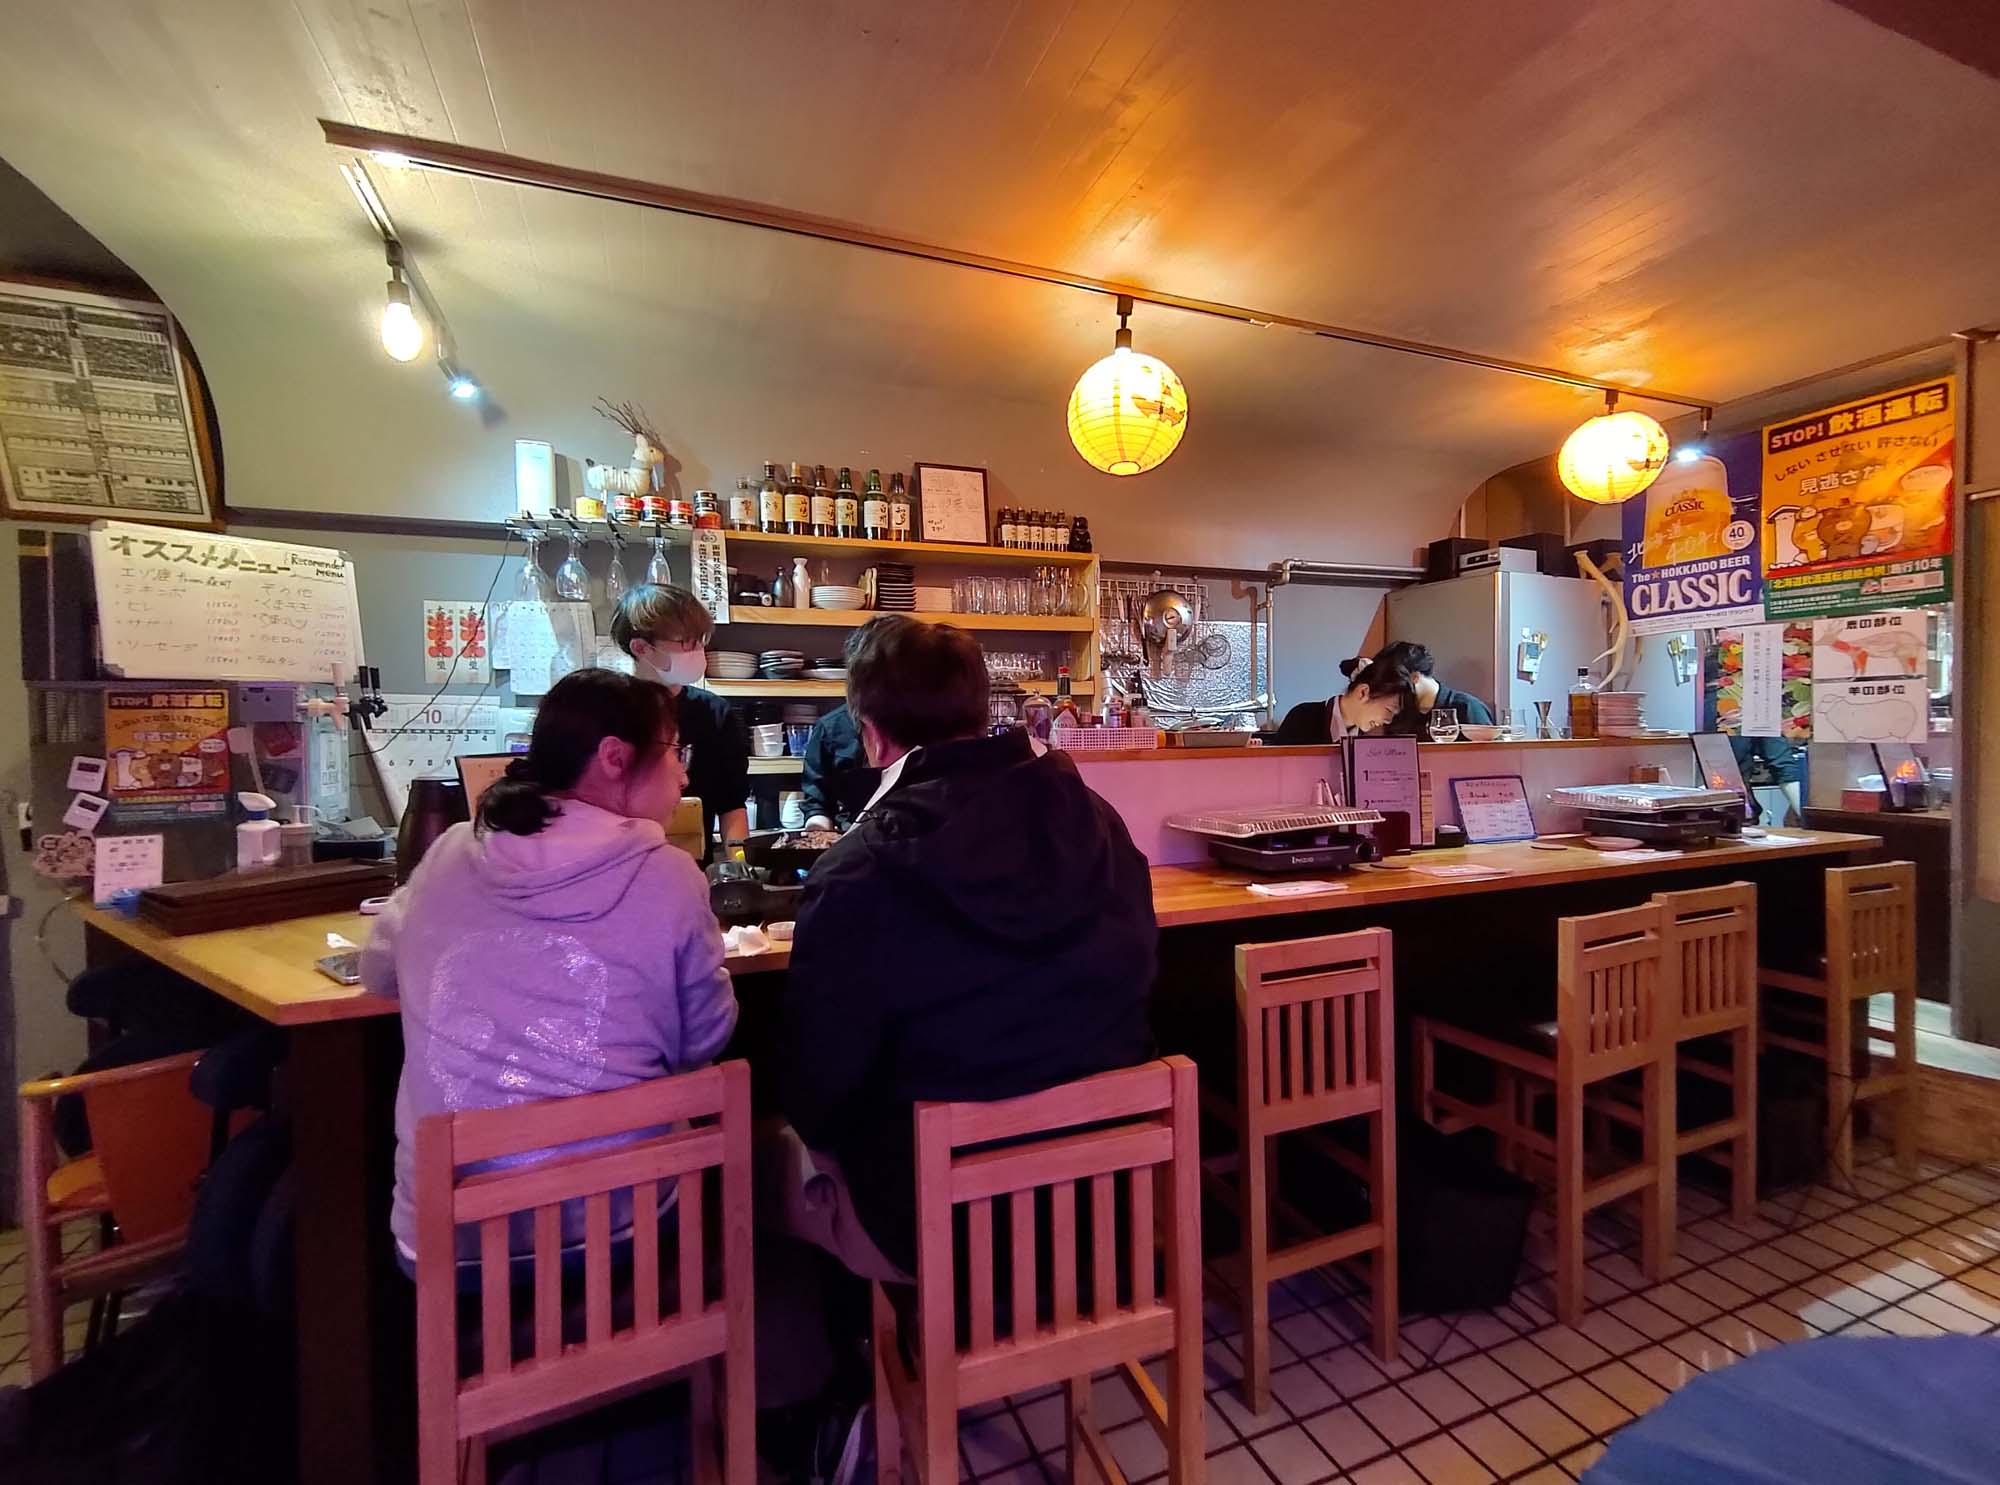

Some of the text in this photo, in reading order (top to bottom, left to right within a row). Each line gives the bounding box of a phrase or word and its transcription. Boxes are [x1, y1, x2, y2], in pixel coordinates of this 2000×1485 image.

[1771, 387, 1944, 449] STOP! 飲酒運転
[1775, 435, 1939, 481] しない させない 許さない
[1665, 500, 1705, 517] CLASSIC
[1729, 526, 1745, 539] 40
[109, 535, 291, 574] オススメメニュー
[1632, 555, 1751, 584] The HOKKAIDO BEER
[1631, 568, 1753, 617] CLASSIC
[1846, 616, 1903, 630] 鹿の部位
[1848, 685, 1906, 696] 羊の部位
[424, 709, 442, 724] 10
